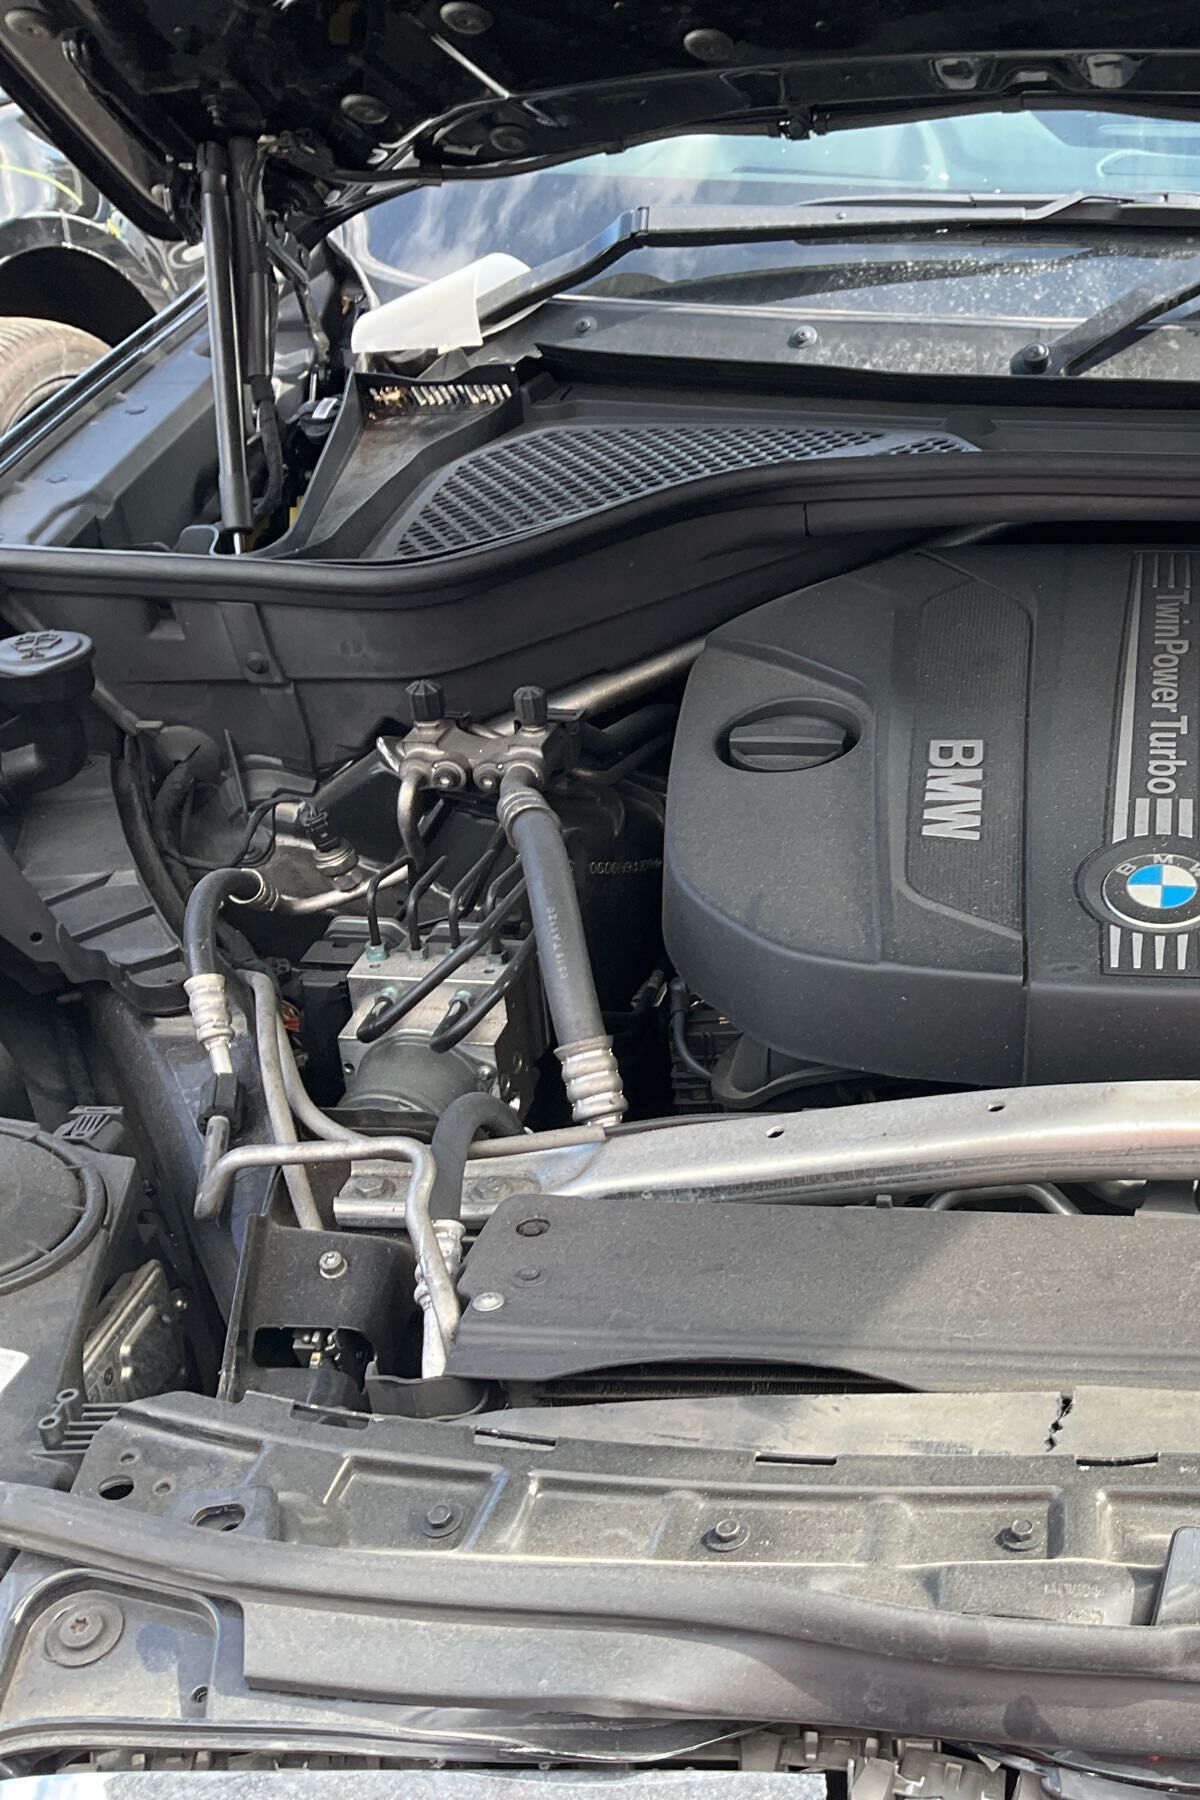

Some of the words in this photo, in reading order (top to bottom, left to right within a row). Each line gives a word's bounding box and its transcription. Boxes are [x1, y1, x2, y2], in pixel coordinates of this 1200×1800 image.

[1151, 590, 1190, 713] TwinPower
[921, 739, 984, 841] BMW
[1147, 715, 1188, 795] Turbo
